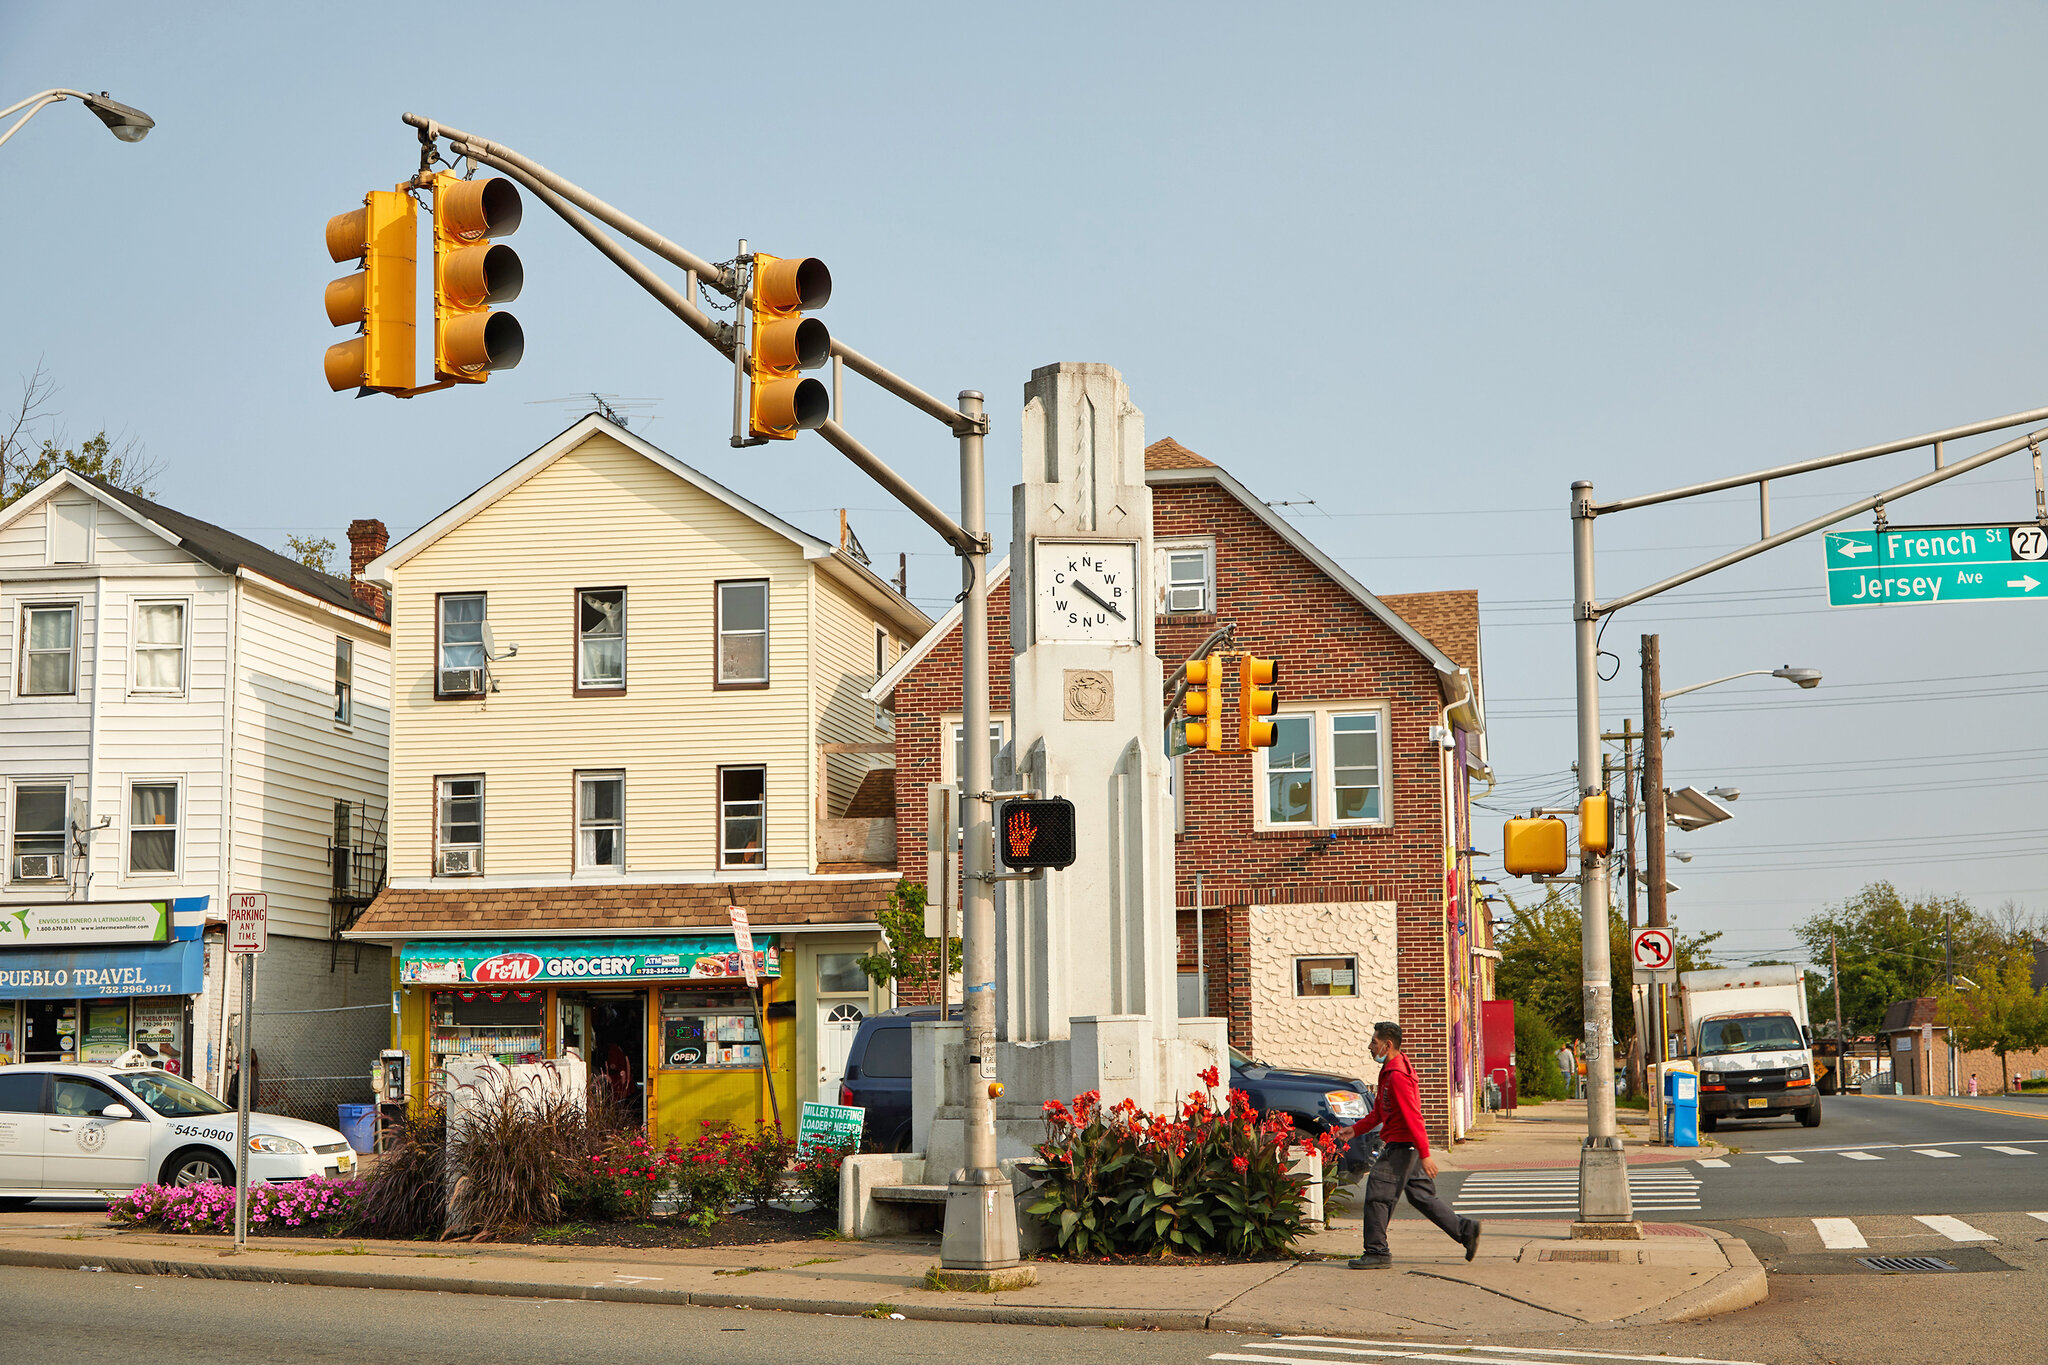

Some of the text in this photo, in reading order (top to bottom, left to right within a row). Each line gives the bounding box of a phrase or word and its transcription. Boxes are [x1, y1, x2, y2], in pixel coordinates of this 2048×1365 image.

[1888, 529, 2042, 558] French St 27
[1852, 570, 1983, 600] Jersey Ave
[241, 896, 256, 908] NO
[98, 915, 146, 923] LATINOAMÉRICA
[231, 908, 264, 921] PARKING
[238, 932, 257, 940] TIME
[645, 956, 662, 966] ATM
[486, 957, 636, 980] F&M GROCERY
[0, 967, 147, 987] PUEBLO TRAVEL
[99, 985, 172, 994] 732.296.9171
[668, 1028, 701, 1038] OPEN
[673, 1053, 697, 1061] OPEN
[804, 1105, 862, 1121] MILLER STAFFING
[802, 1118, 833, 1131] LOADERS
[174, 1124, 234, 1142] 545-0900
